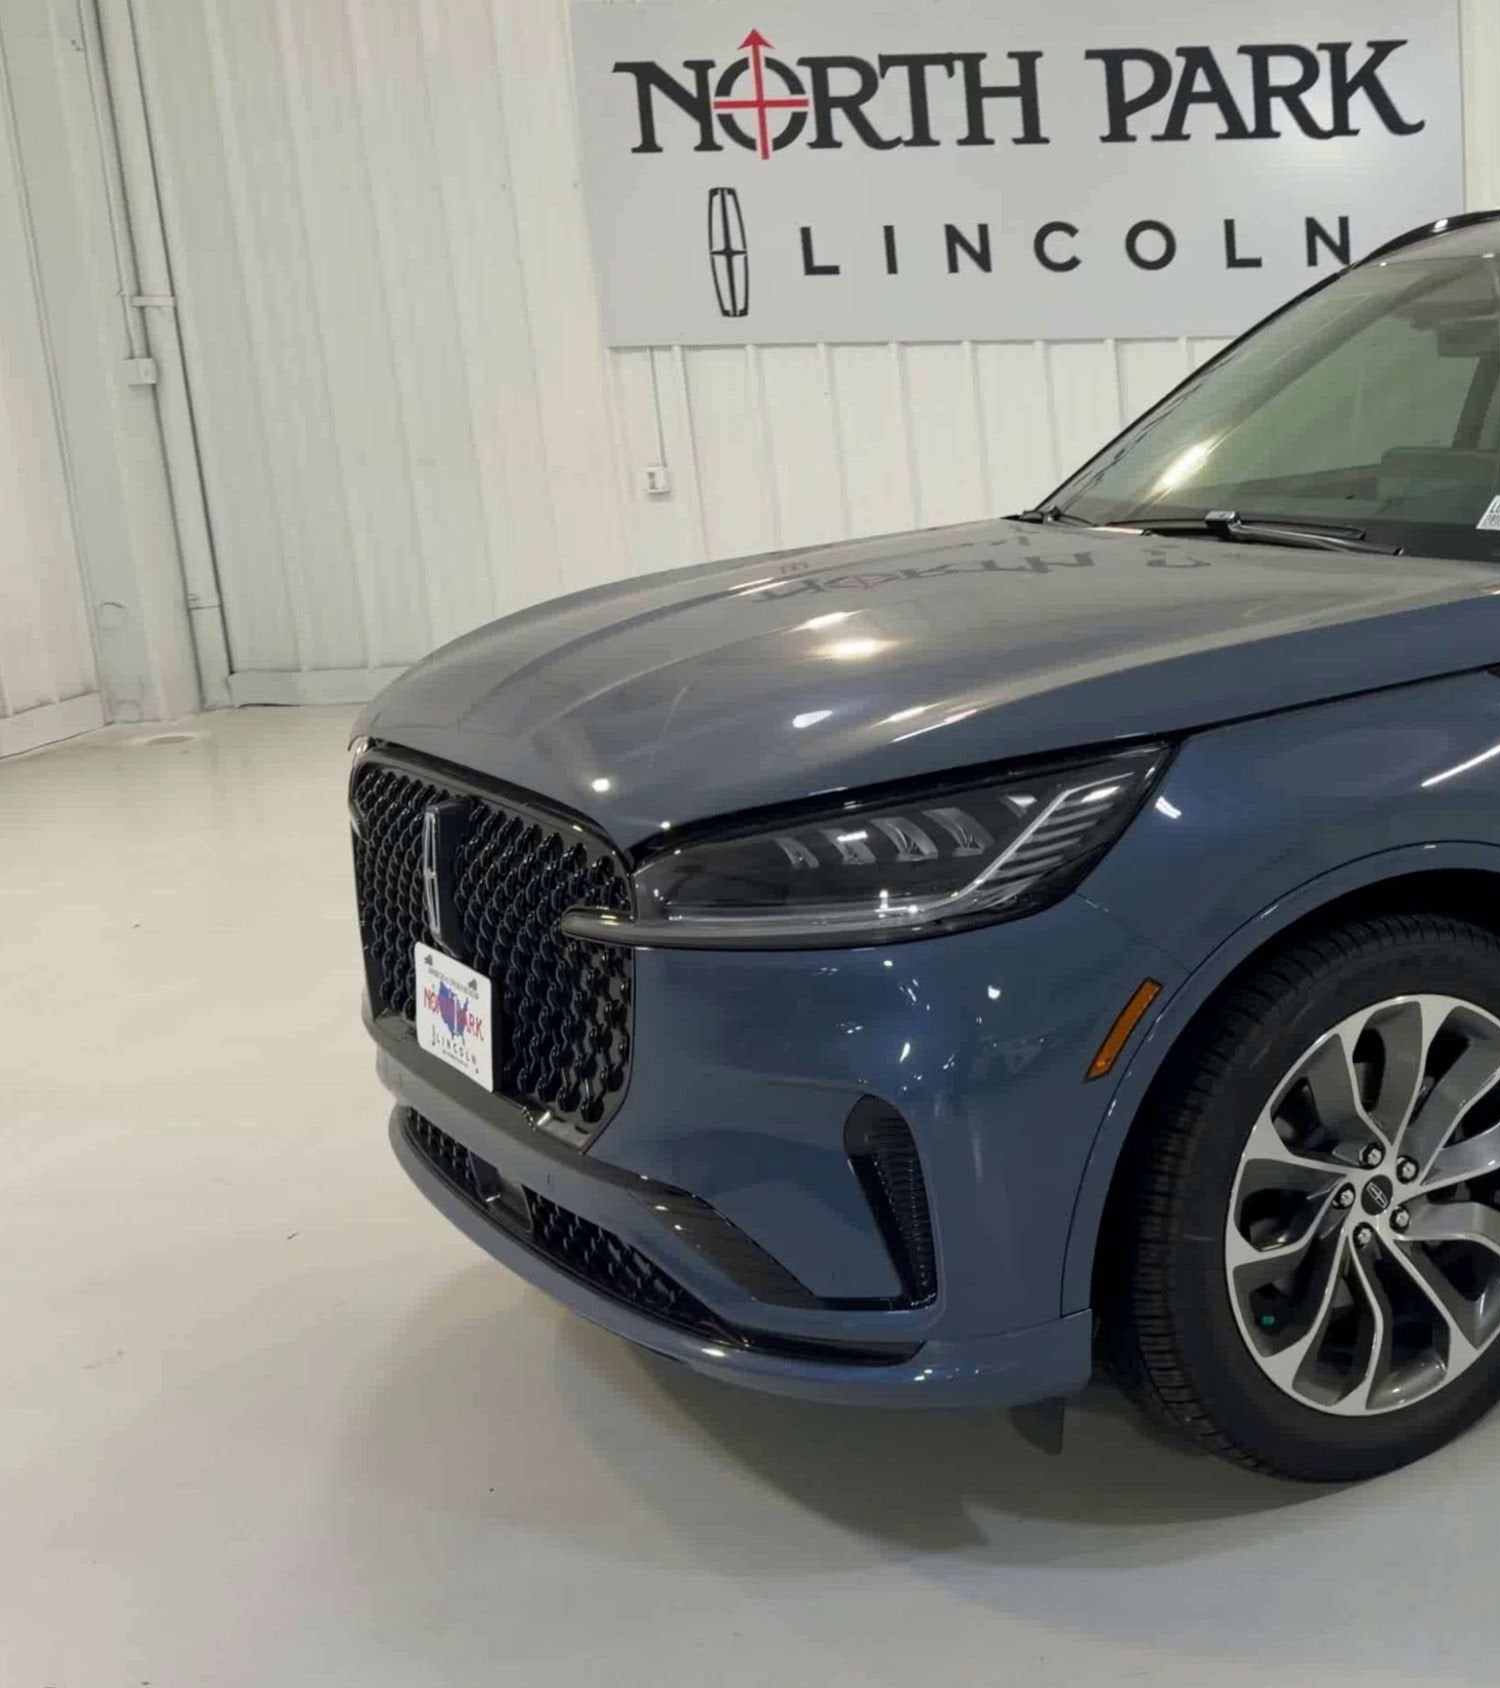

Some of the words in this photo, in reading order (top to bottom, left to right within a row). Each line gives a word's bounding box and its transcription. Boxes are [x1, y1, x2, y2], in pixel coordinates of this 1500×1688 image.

[612, 49, 1051, 154] NORTH
[1085, 39, 1425, 142] PARK
[800, 215, 1351, 276] LINCOLN
[436, 1033, 477, 1066] LINCOLN
